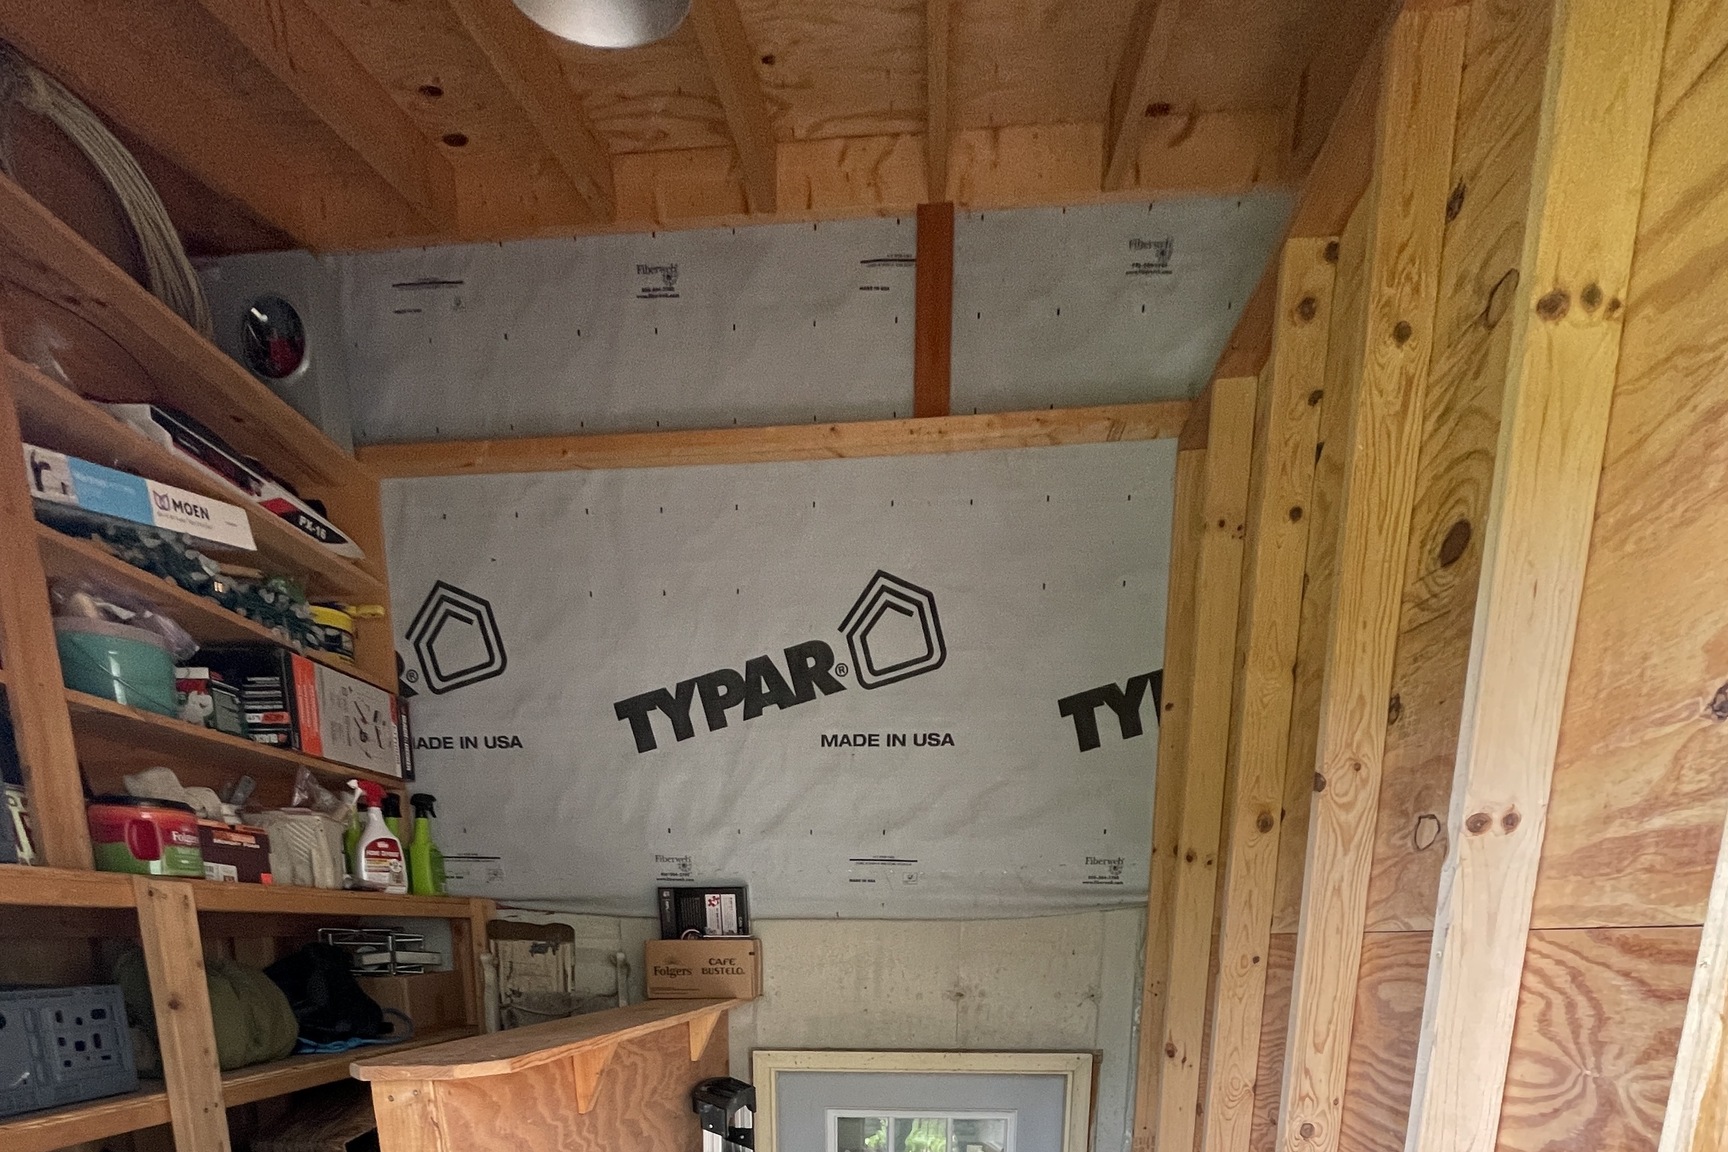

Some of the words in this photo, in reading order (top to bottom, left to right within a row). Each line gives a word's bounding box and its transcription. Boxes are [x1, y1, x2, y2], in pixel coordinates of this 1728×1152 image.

[171, 498, 211, 520] MOEN
[613, 639, 848, 754] TYPAR
[413, 736, 454, 750] ADE
[460, 736, 478, 749] IN
[484, 735, 523, 749] USA
[820, 733, 880, 747] MADE
[886, 733, 906, 747] IN
[913, 733, 956, 747] USA
[653, 965, 693, 978] Folgers
